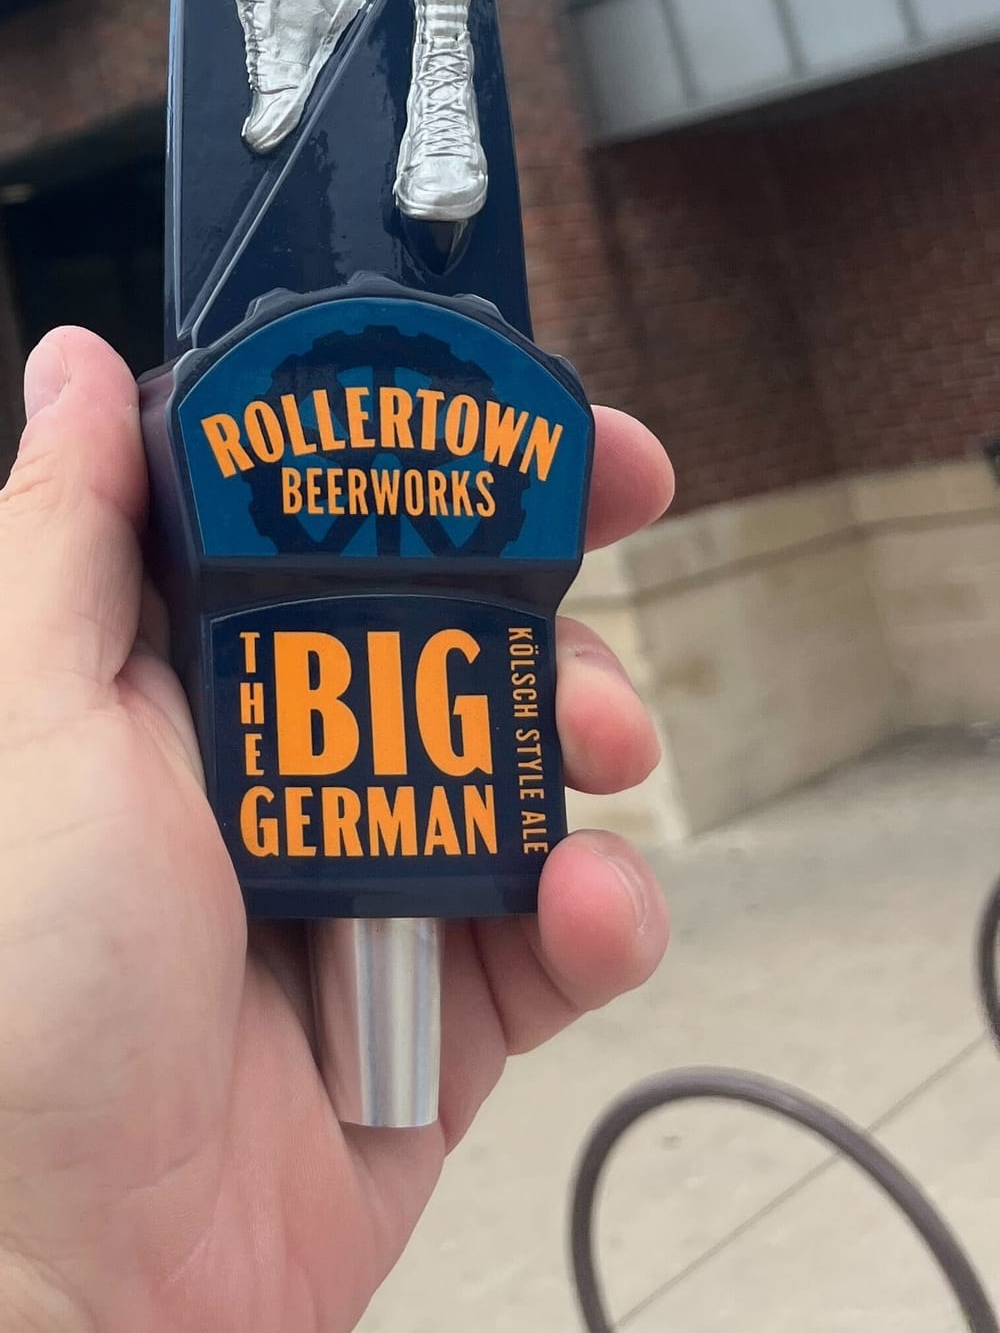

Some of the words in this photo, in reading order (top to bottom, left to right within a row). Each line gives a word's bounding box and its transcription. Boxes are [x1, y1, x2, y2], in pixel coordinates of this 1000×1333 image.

[201, 386, 564, 482] ROLLERTOWN
[281, 467, 497, 518] BEERWORKS
[239, 631, 266, 777] THE
[273, 628, 494, 777] BIG
[509, 626, 539, 718] KÖLSCH
[514, 728, 546, 801] STYLE
[239, 784, 499, 858] GERMAN
[521, 810, 549, 855] ALE
